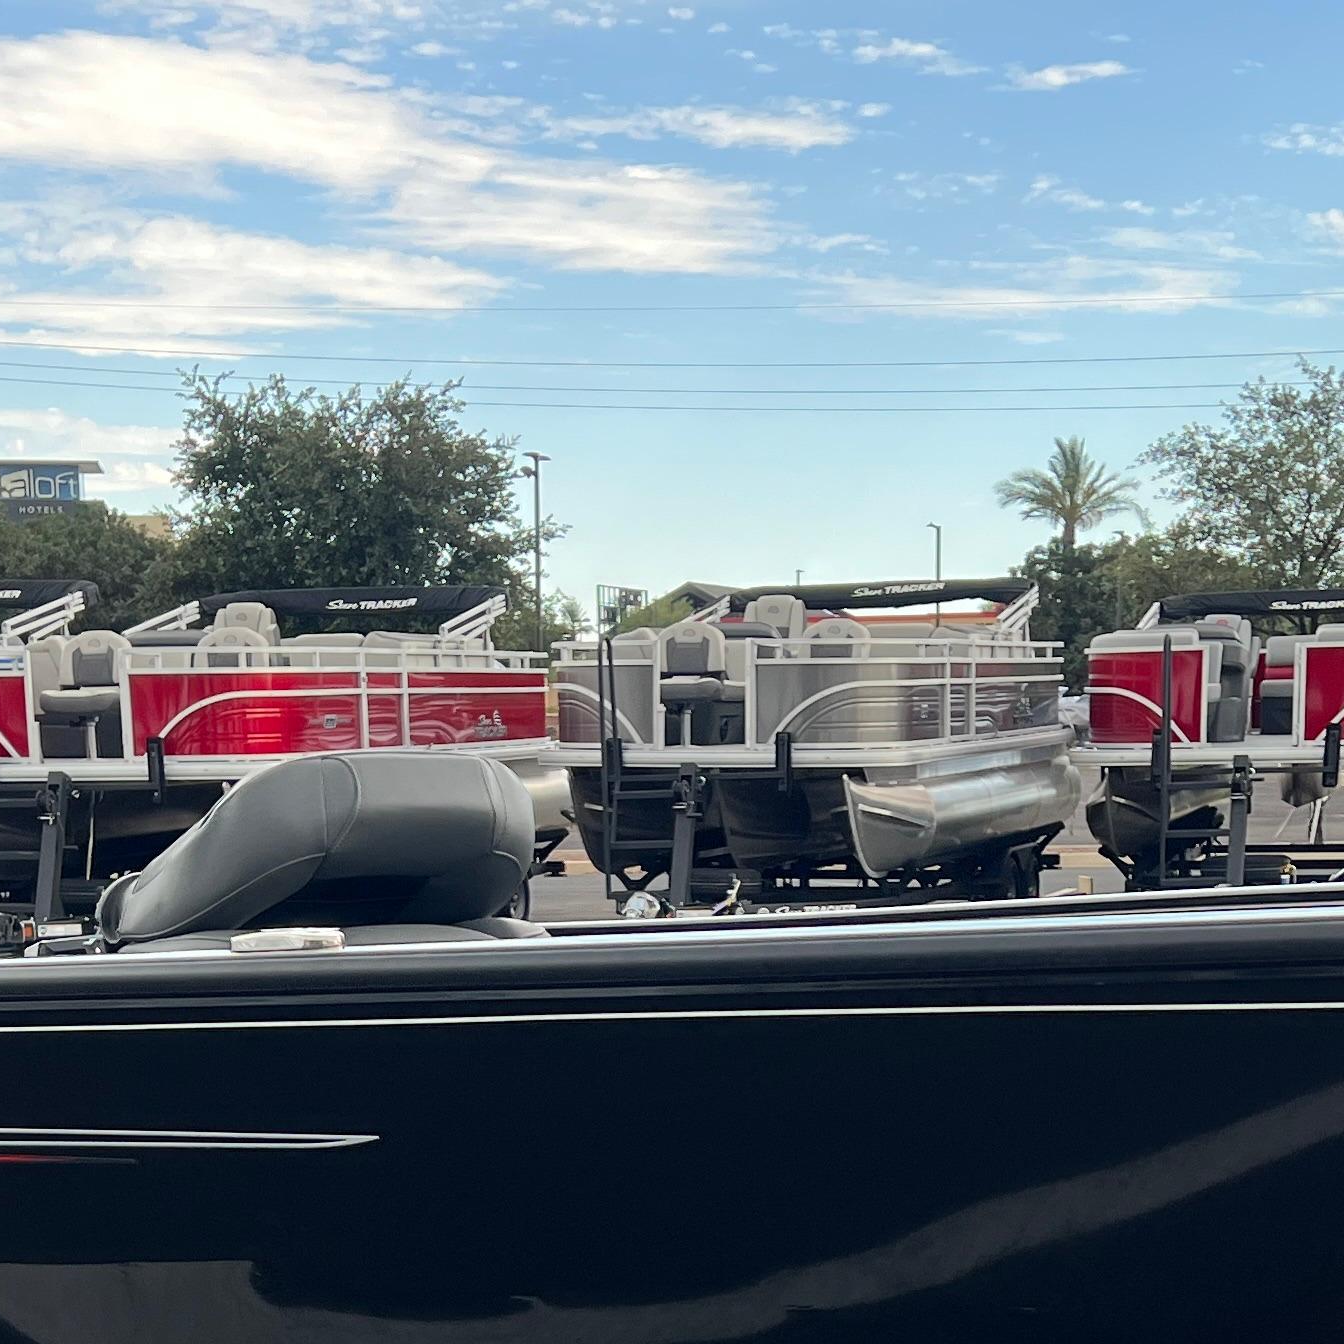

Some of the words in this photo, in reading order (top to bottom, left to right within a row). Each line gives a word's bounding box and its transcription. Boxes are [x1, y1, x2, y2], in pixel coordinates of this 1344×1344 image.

[1, 468, 78, 499] aloft
[18, 505, 64, 515] HOTELS
[884, 581, 946, 595] TRACKER
[359, 597, 418, 610] TRACKER
